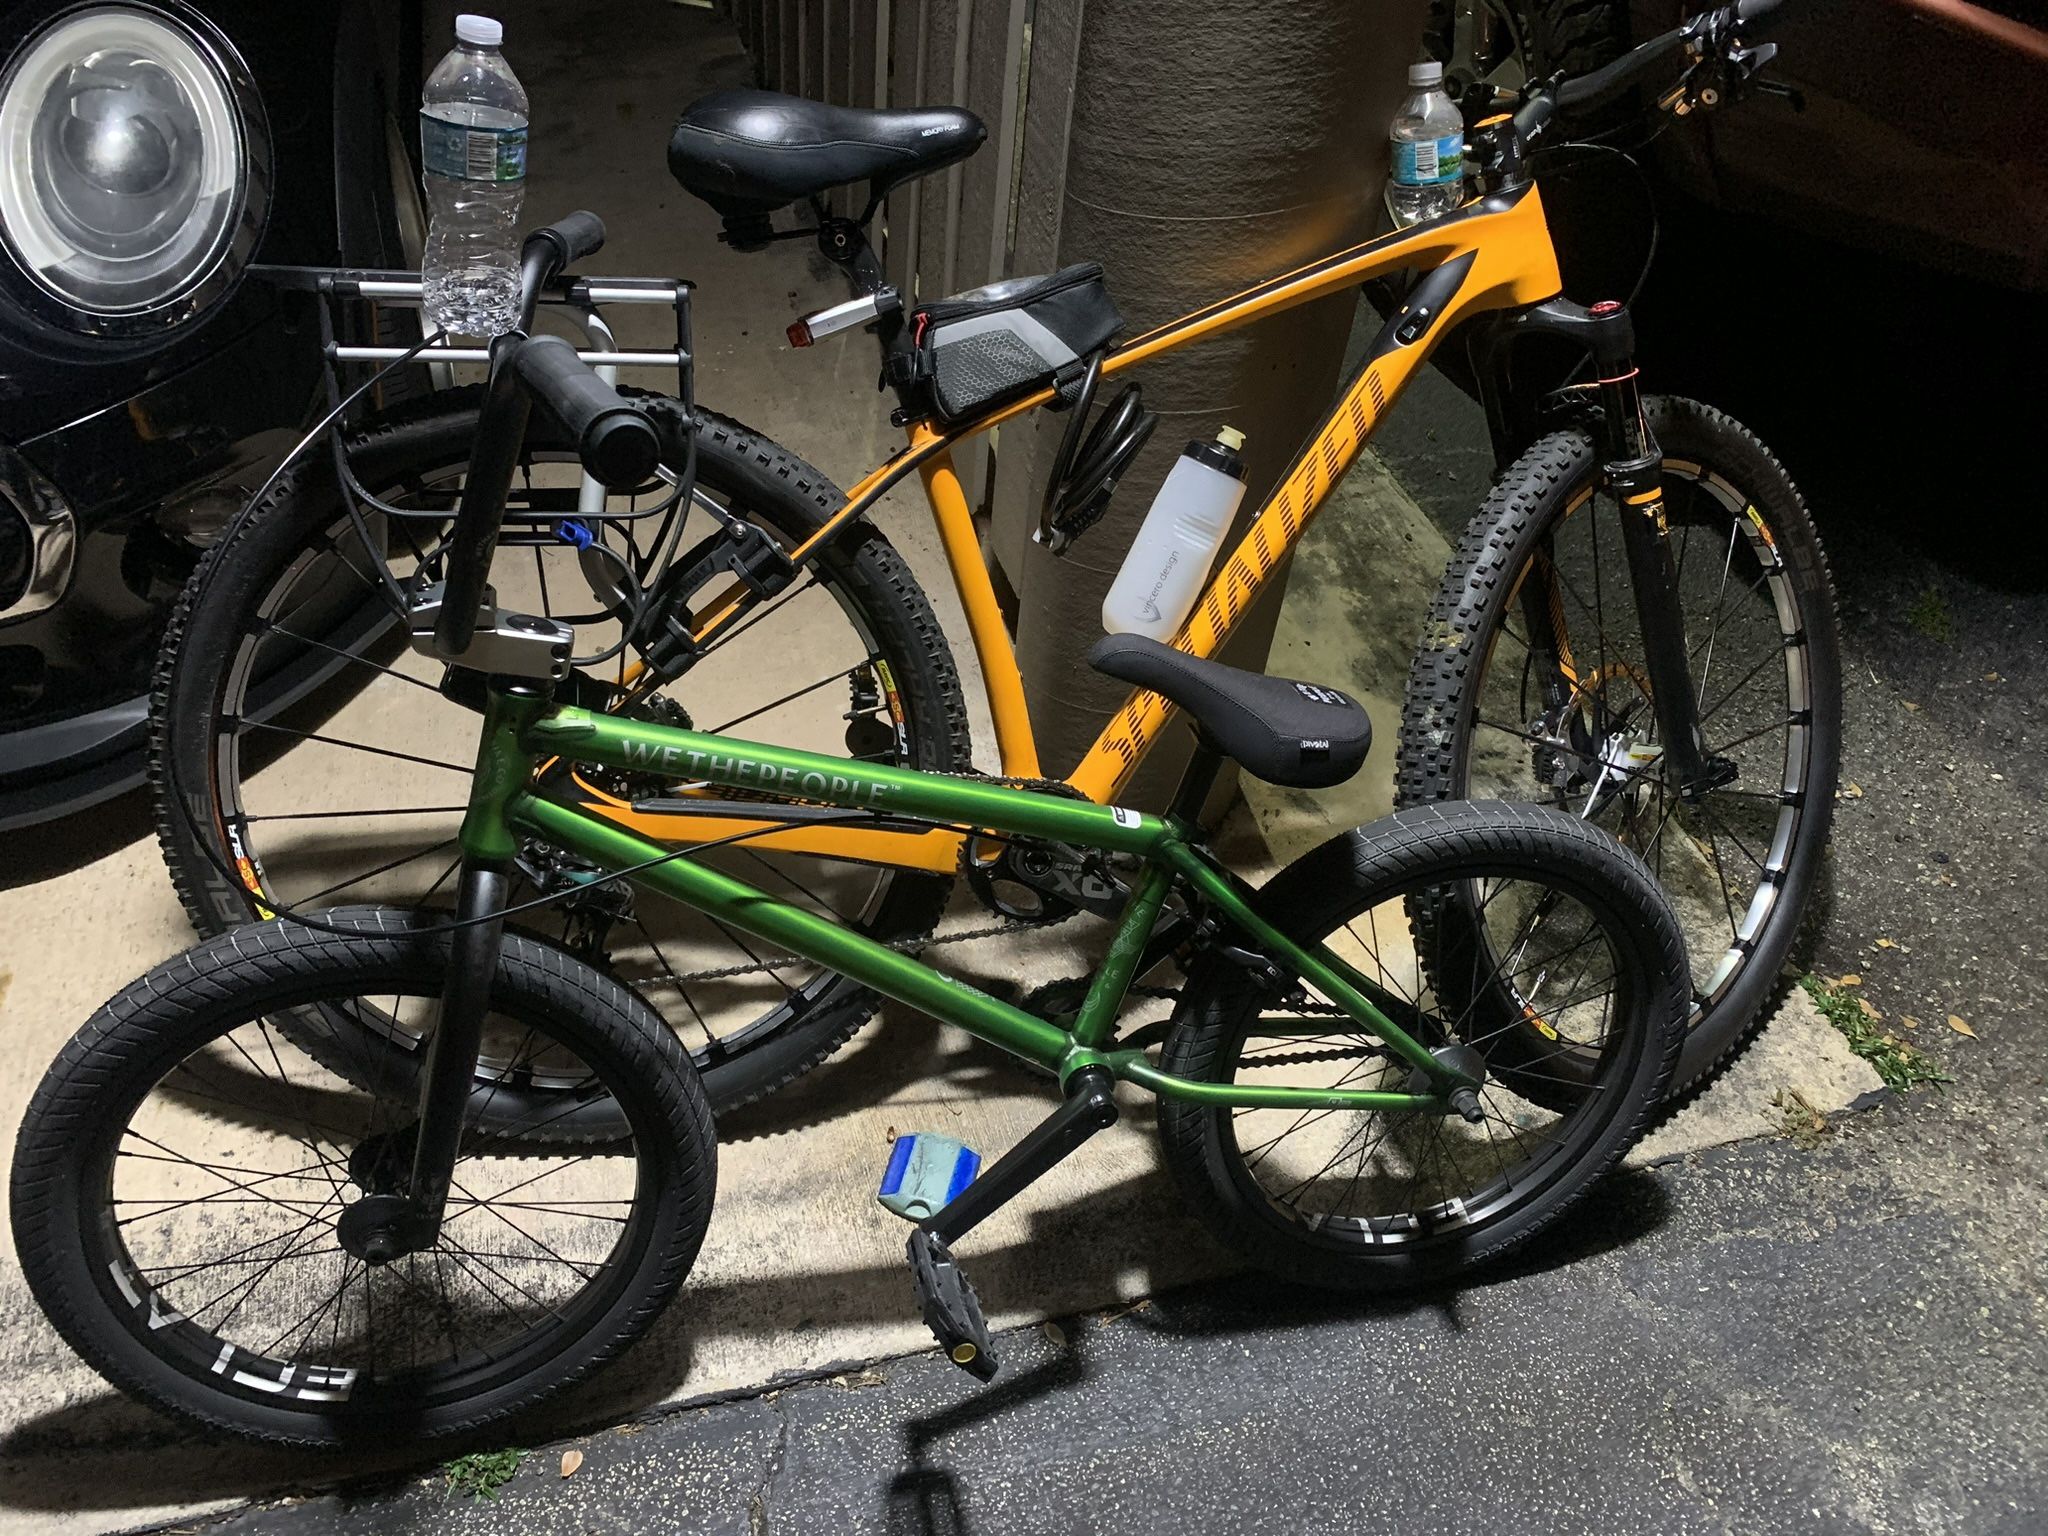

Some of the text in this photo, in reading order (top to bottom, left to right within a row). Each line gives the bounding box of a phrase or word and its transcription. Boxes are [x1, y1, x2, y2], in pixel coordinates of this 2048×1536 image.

[1101, 368, 1387, 786] SPCIALIZED
[1143, 550, 1180, 614] vincero design
[622, 739, 888, 804] WETHEPEOPLE
[228, 824, 245, 858] SLR
[1055, 862, 1083, 872] SRA
